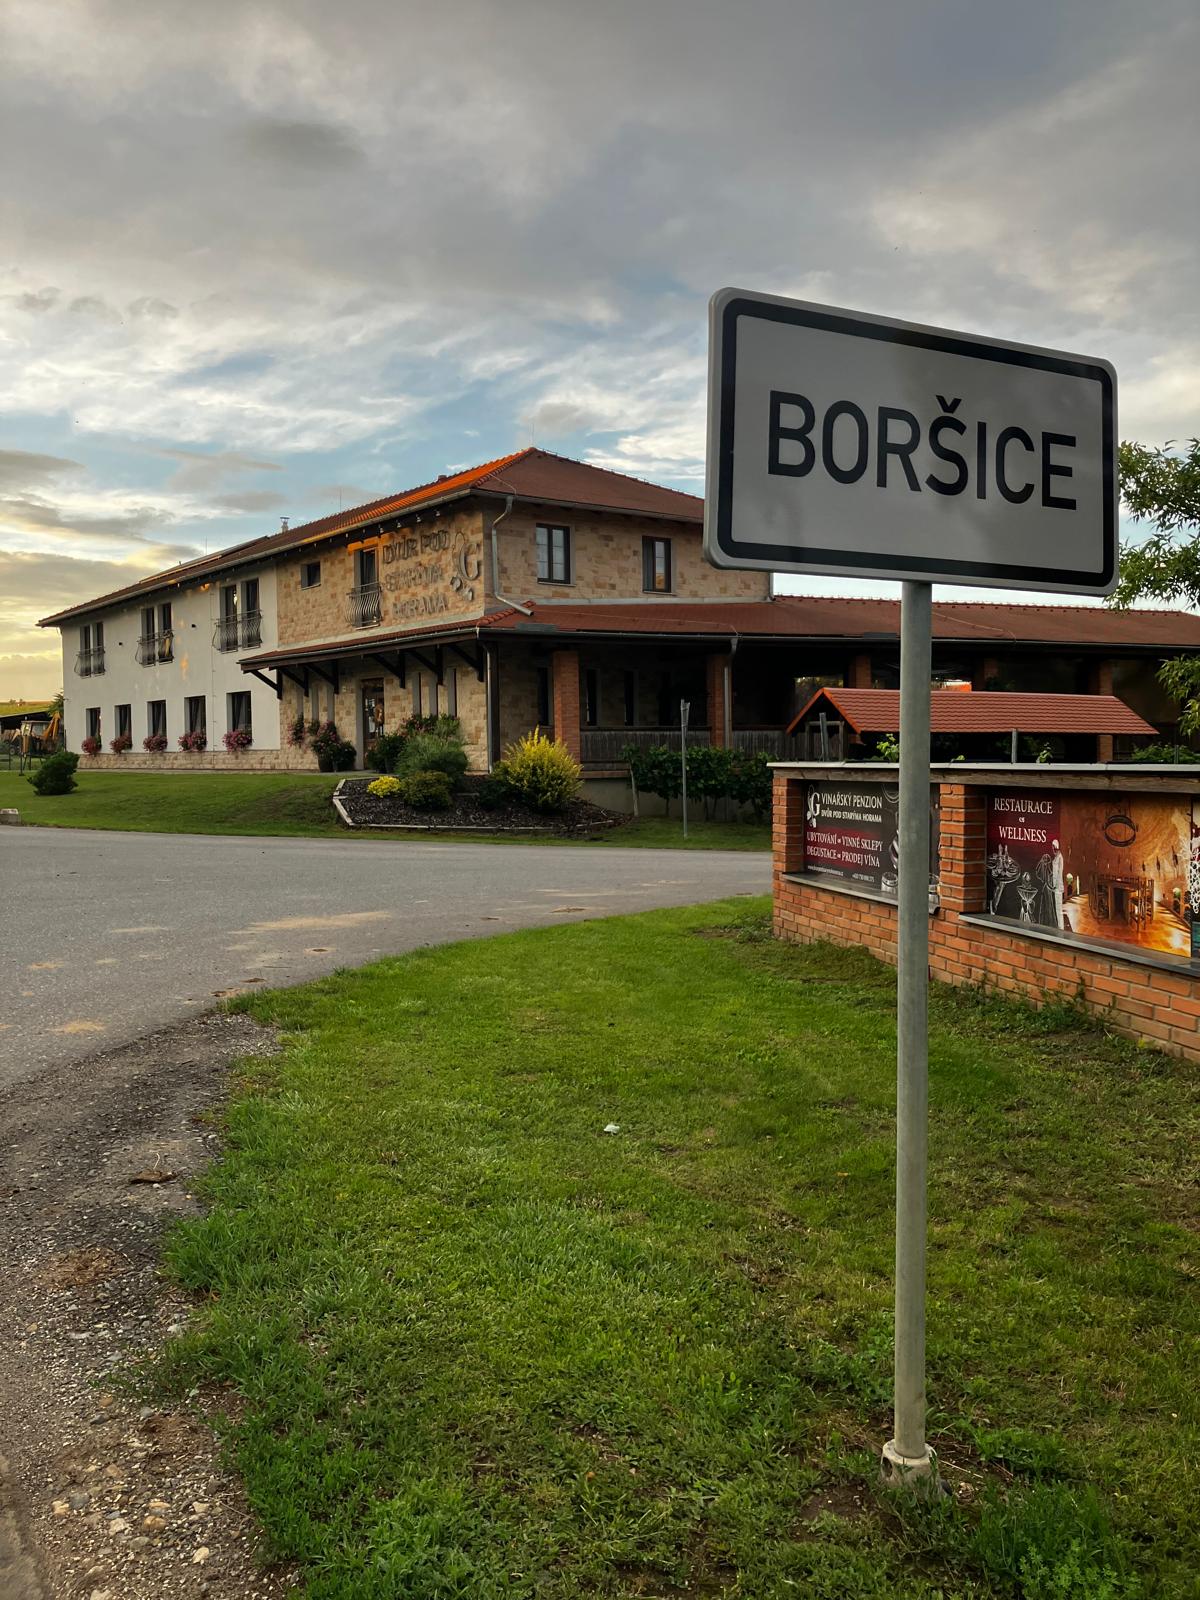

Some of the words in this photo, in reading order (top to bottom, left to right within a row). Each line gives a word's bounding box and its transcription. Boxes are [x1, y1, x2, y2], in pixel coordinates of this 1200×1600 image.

[768, 389, 1077, 511] BORŠICE
[420, 530, 450, 553] POD
[821, 792, 852, 806] VINAŘSKÝ
[853, 795, 883, 809] PENZION
[994, 797, 1053, 814] RESTAURACE
[863, 814, 882, 823] HORAMA
[806, 831, 837, 844] UBYTOVÁNÍ
[841, 836, 860, 848] VINNÉ
[861, 839, 883, 852] SKLEPY
[998, 825, 1047, 843] WELLNESS
[806, 846, 837, 859] DEGUSTACE
[841, 852, 863, 866] PRODEJ
[864, 854, 880, 867] VÍNA
